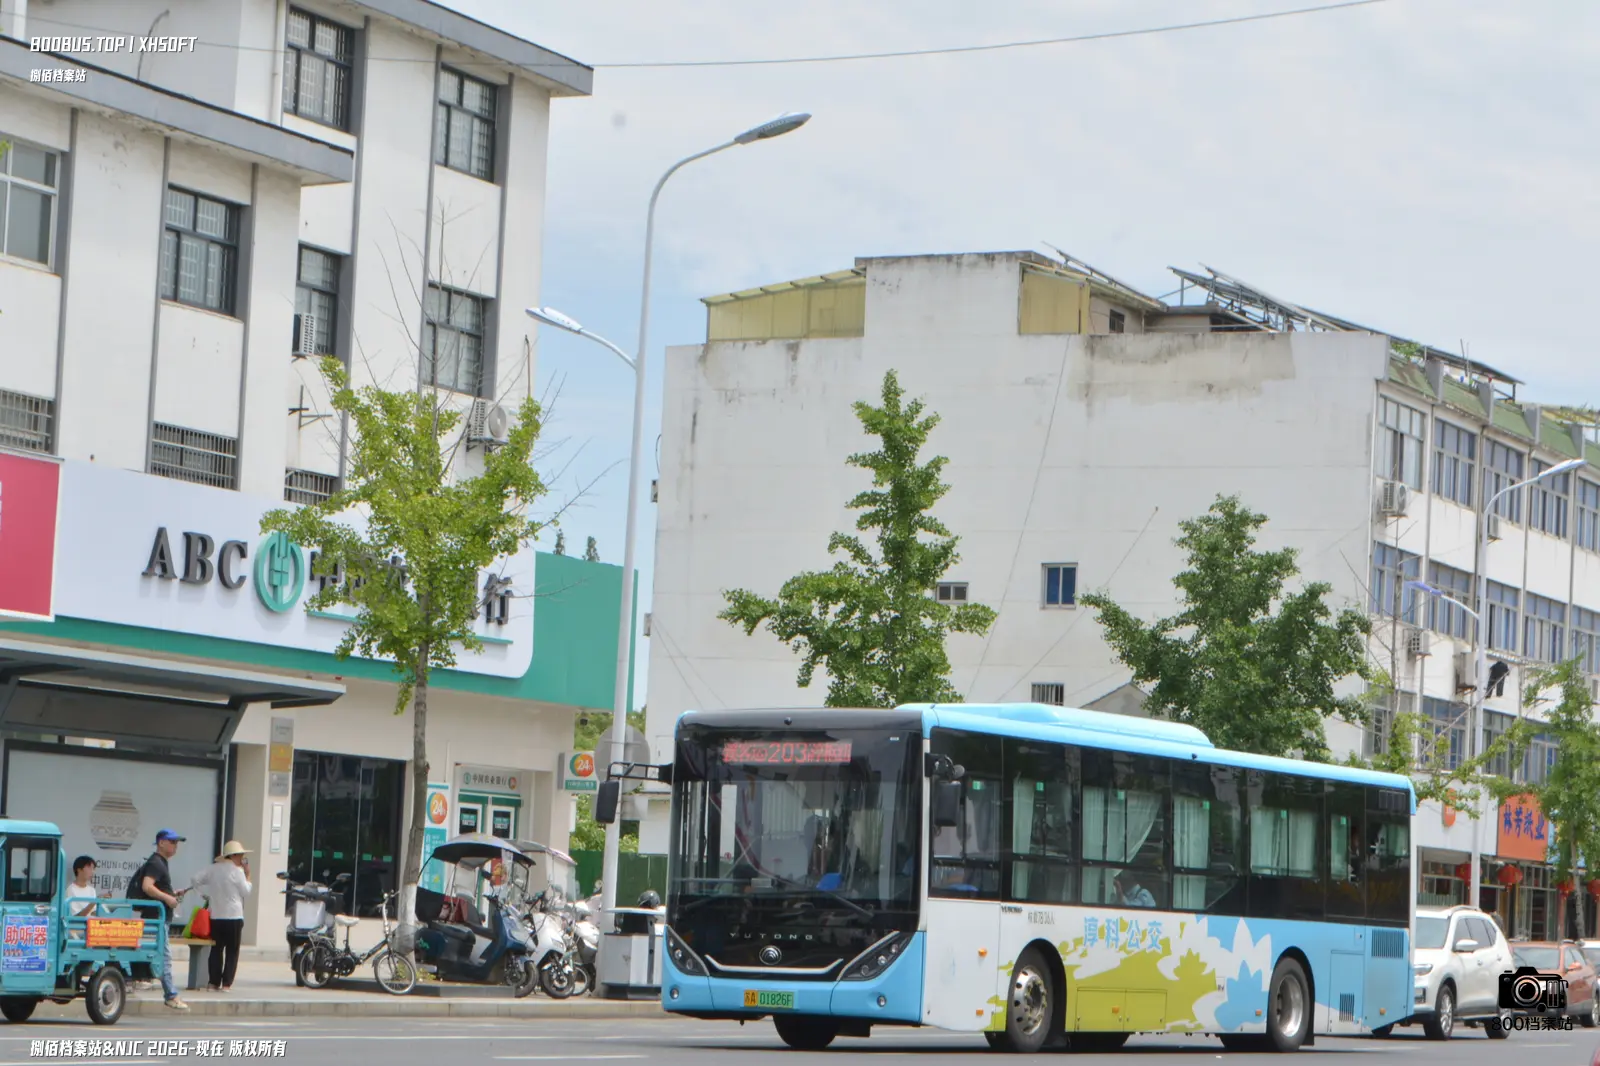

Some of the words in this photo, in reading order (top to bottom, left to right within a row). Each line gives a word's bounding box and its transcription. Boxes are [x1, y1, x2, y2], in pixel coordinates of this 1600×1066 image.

[141, 526, 249, 590] ABC
[4, 925, 47, 945] 助听器
[730, 932, 813, 940] YUTONG
